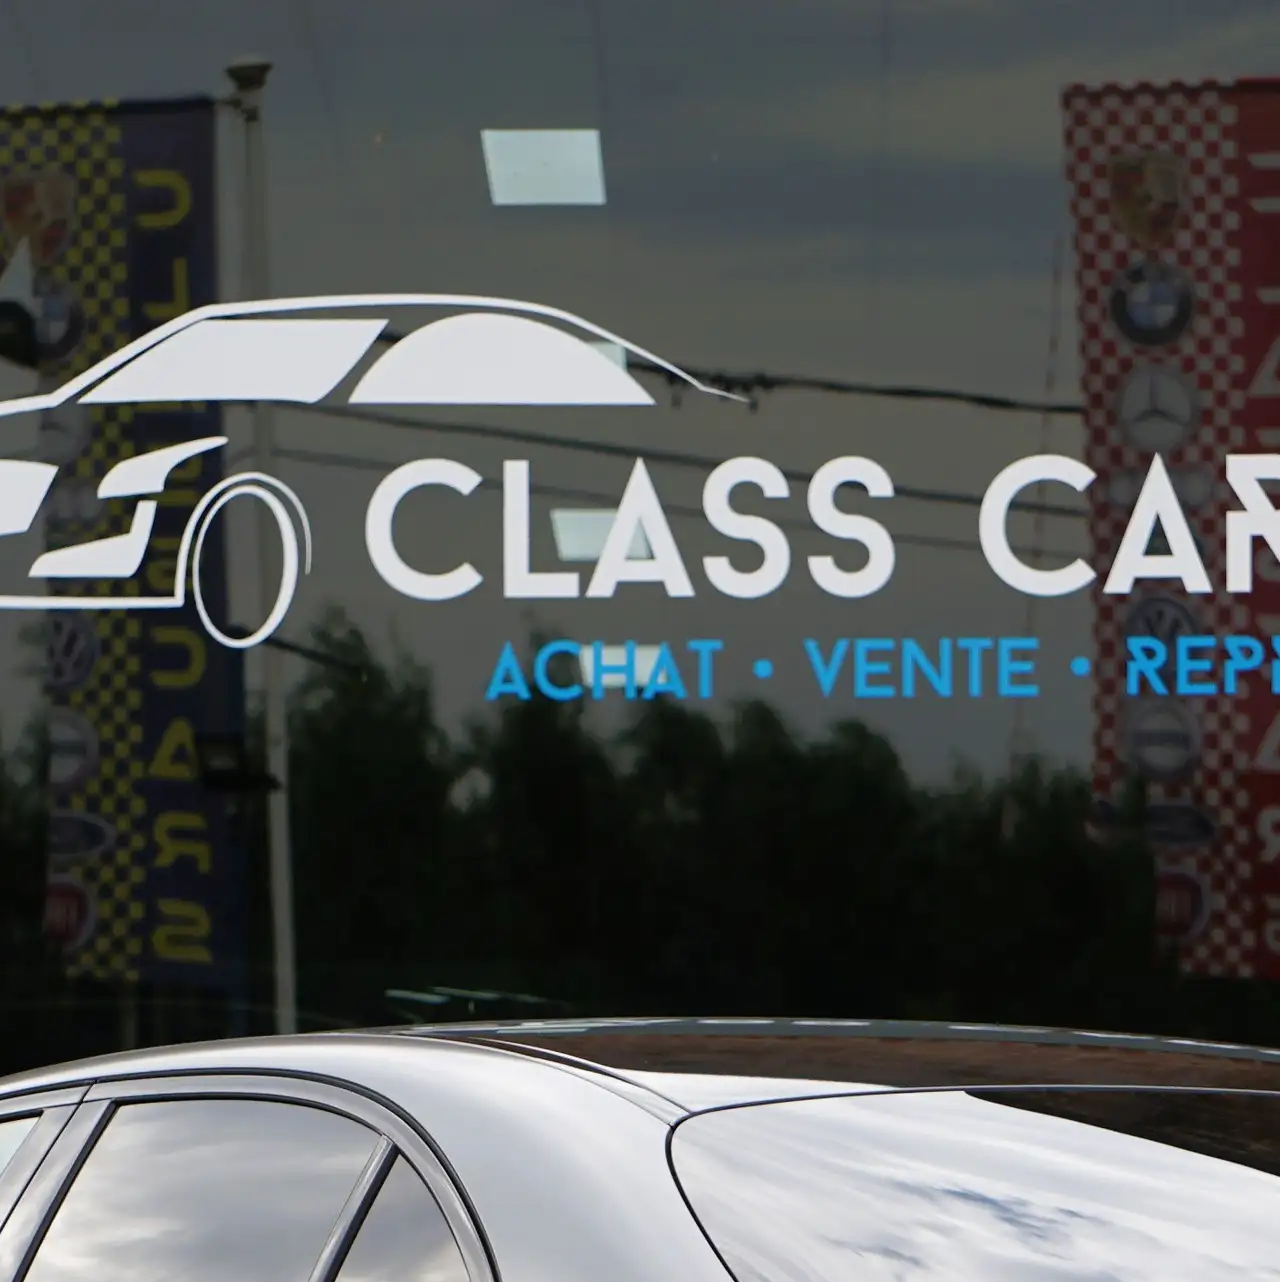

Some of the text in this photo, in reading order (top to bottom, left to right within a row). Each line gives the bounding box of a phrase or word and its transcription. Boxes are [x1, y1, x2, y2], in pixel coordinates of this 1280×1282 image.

[365, 456, 895, 600] CLASS
[485, 640, 724, 702] ACHAT
[804, 637, 1040, 699] VENTE
